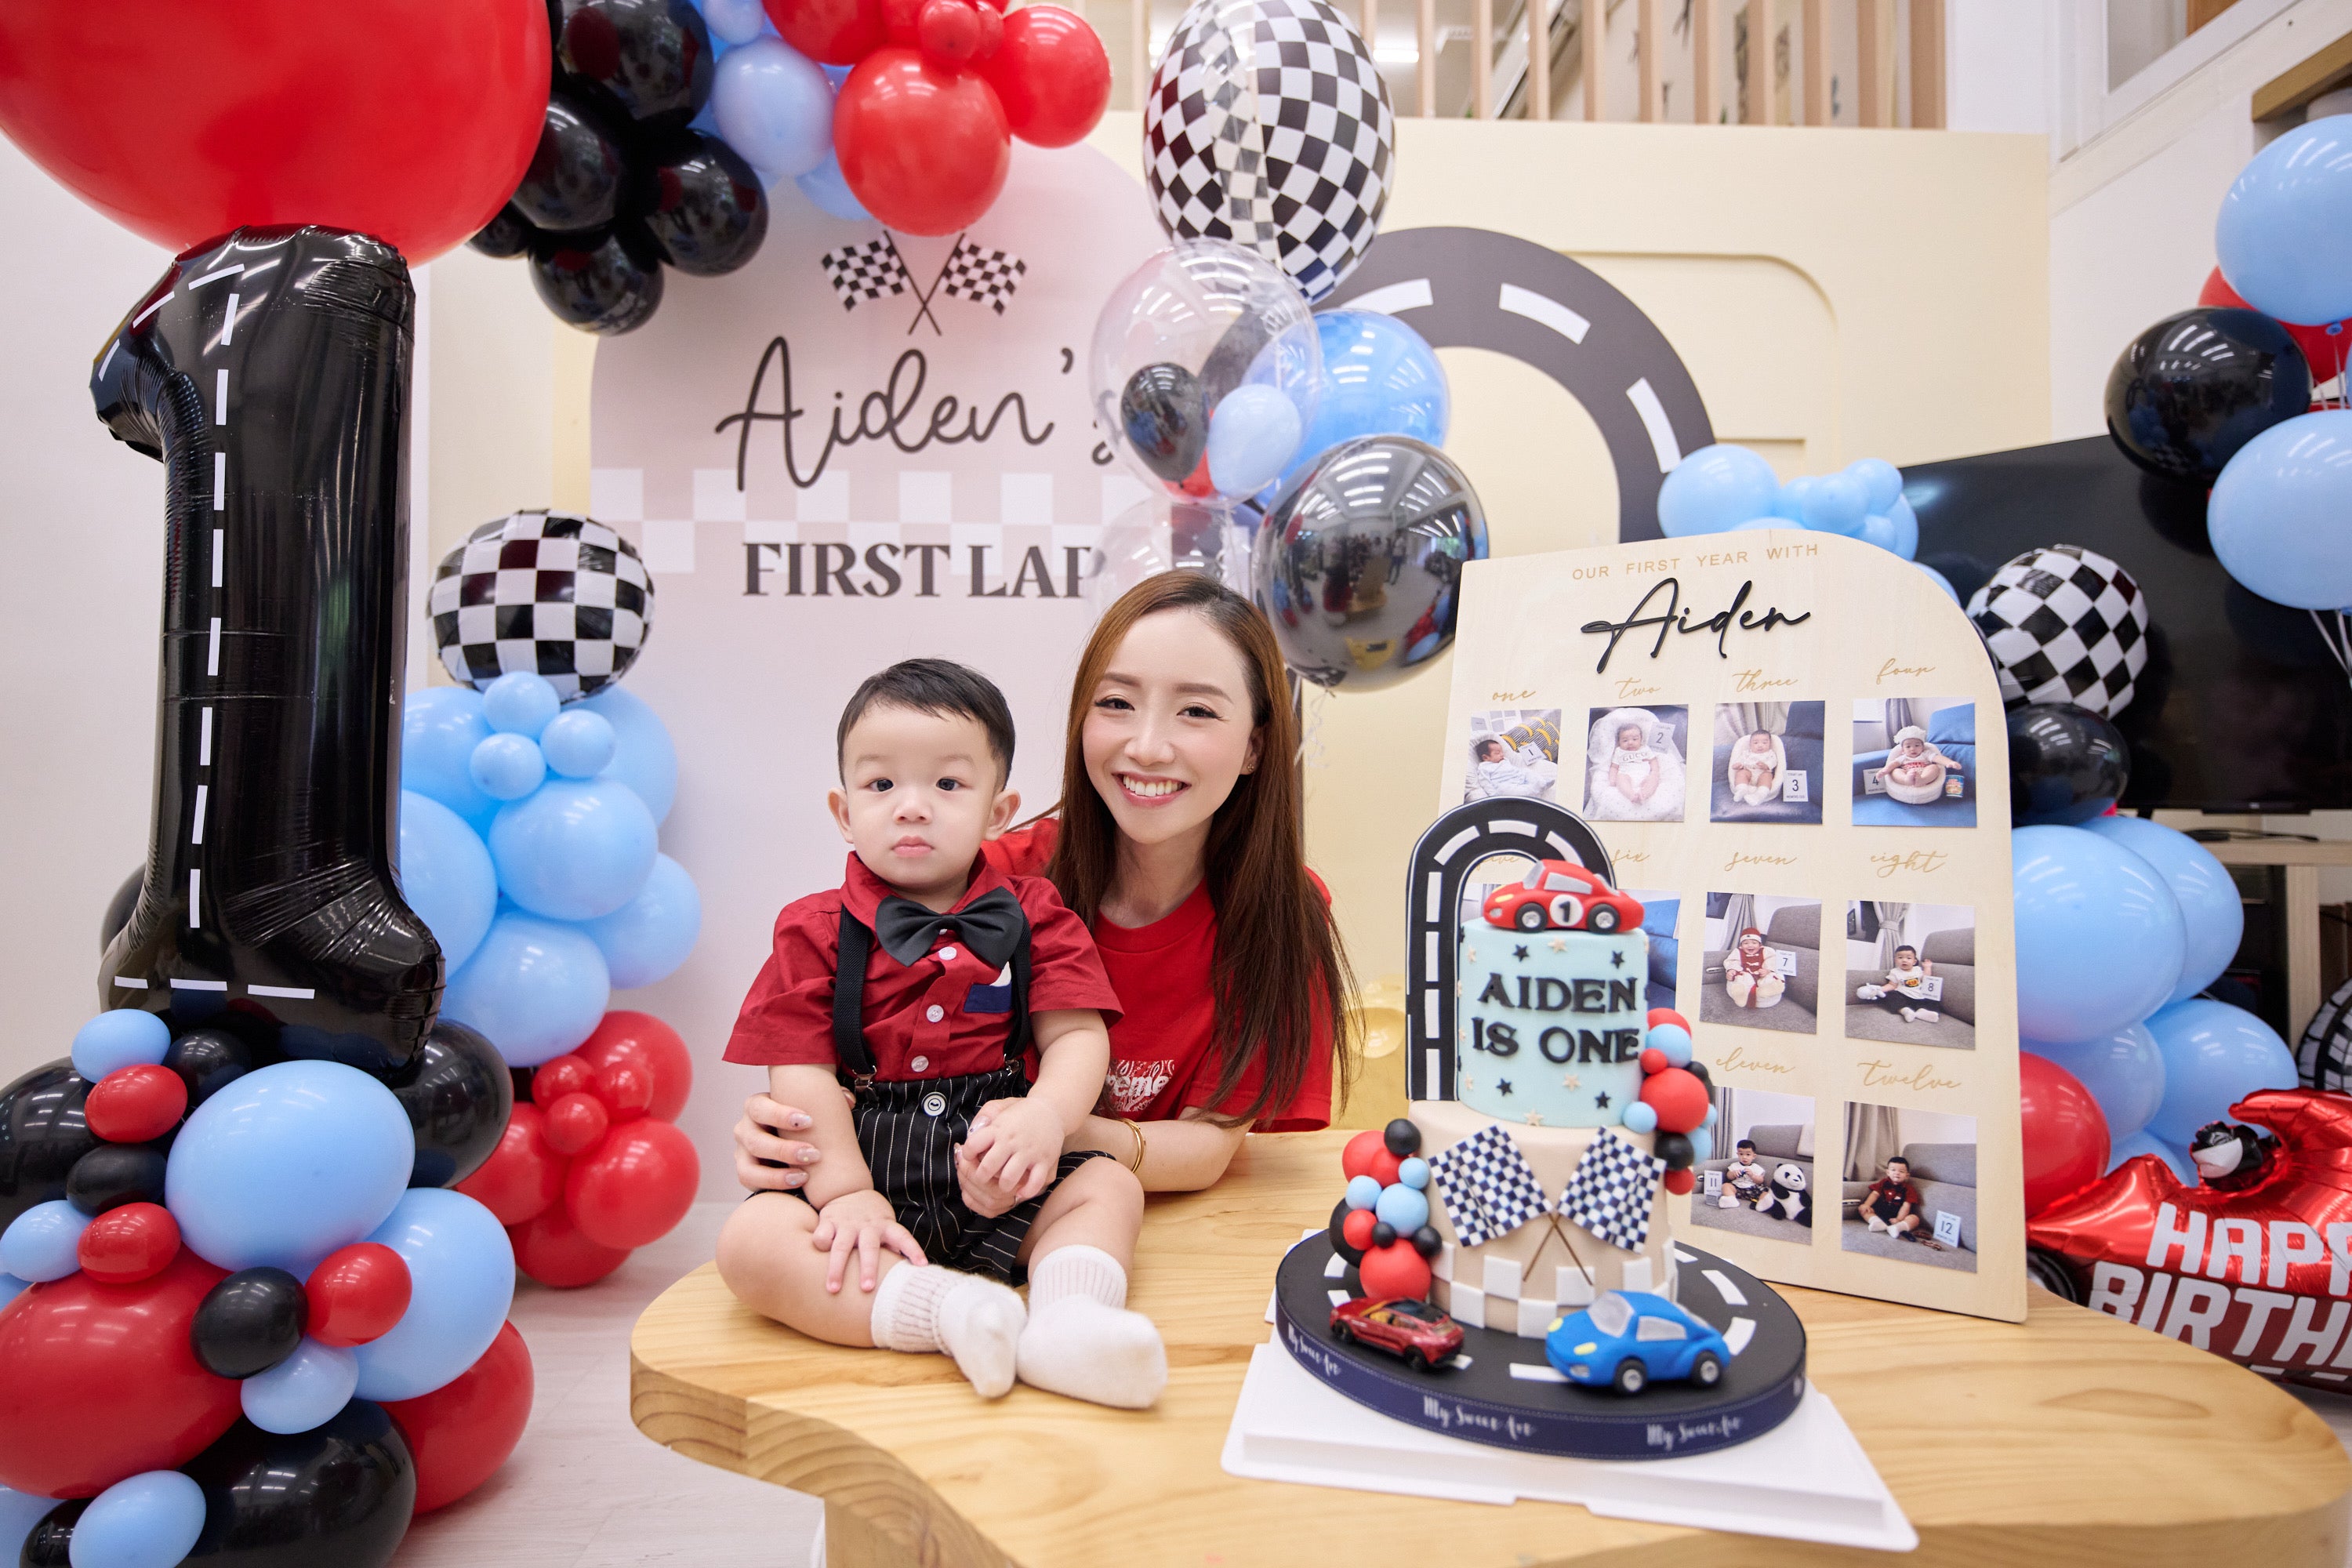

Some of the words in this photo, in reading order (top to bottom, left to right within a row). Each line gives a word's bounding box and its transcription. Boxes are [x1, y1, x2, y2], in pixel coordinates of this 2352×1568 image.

[742, 543, 951, 597] FIRST
[1572, 565, 1610, 580] OUR
[1625, 557, 1681, 575] FIRST
[1697, 551, 1749, 568] YEAR
[1766, 543, 1819, 560] WITH
[1581, 577, 1811, 674] Aiden
[1732, 669, 1798, 693] three
[1875, 658, 1936, 684] four
[1491, 689, 1537, 702] one
[1615, 677, 1661, 700] two
[1655, 731, 1664, 744] 2
[1792, 779, 1799, 792] 3
[1612, 849, 1650, 867] six
[1724, 851, 1798, 872] seven
[1870, 851, 1949, 878] eight
[1558, 901, 1571, 923] 1
[1782, 957, 1788, 967] 7
[1478, 973, 1638, 1014] AIDEN
[1928, 982, 1934, 992] 8
[1472, 1017, 1519, 1057] IS
[1539, 1027, 1639, 1065] ONE
[1716, 1047, 1796, 1075] eleven
[1857, 1059, 1962, 1092] twelve
[1940, 1221, 1952, 1235] 12
